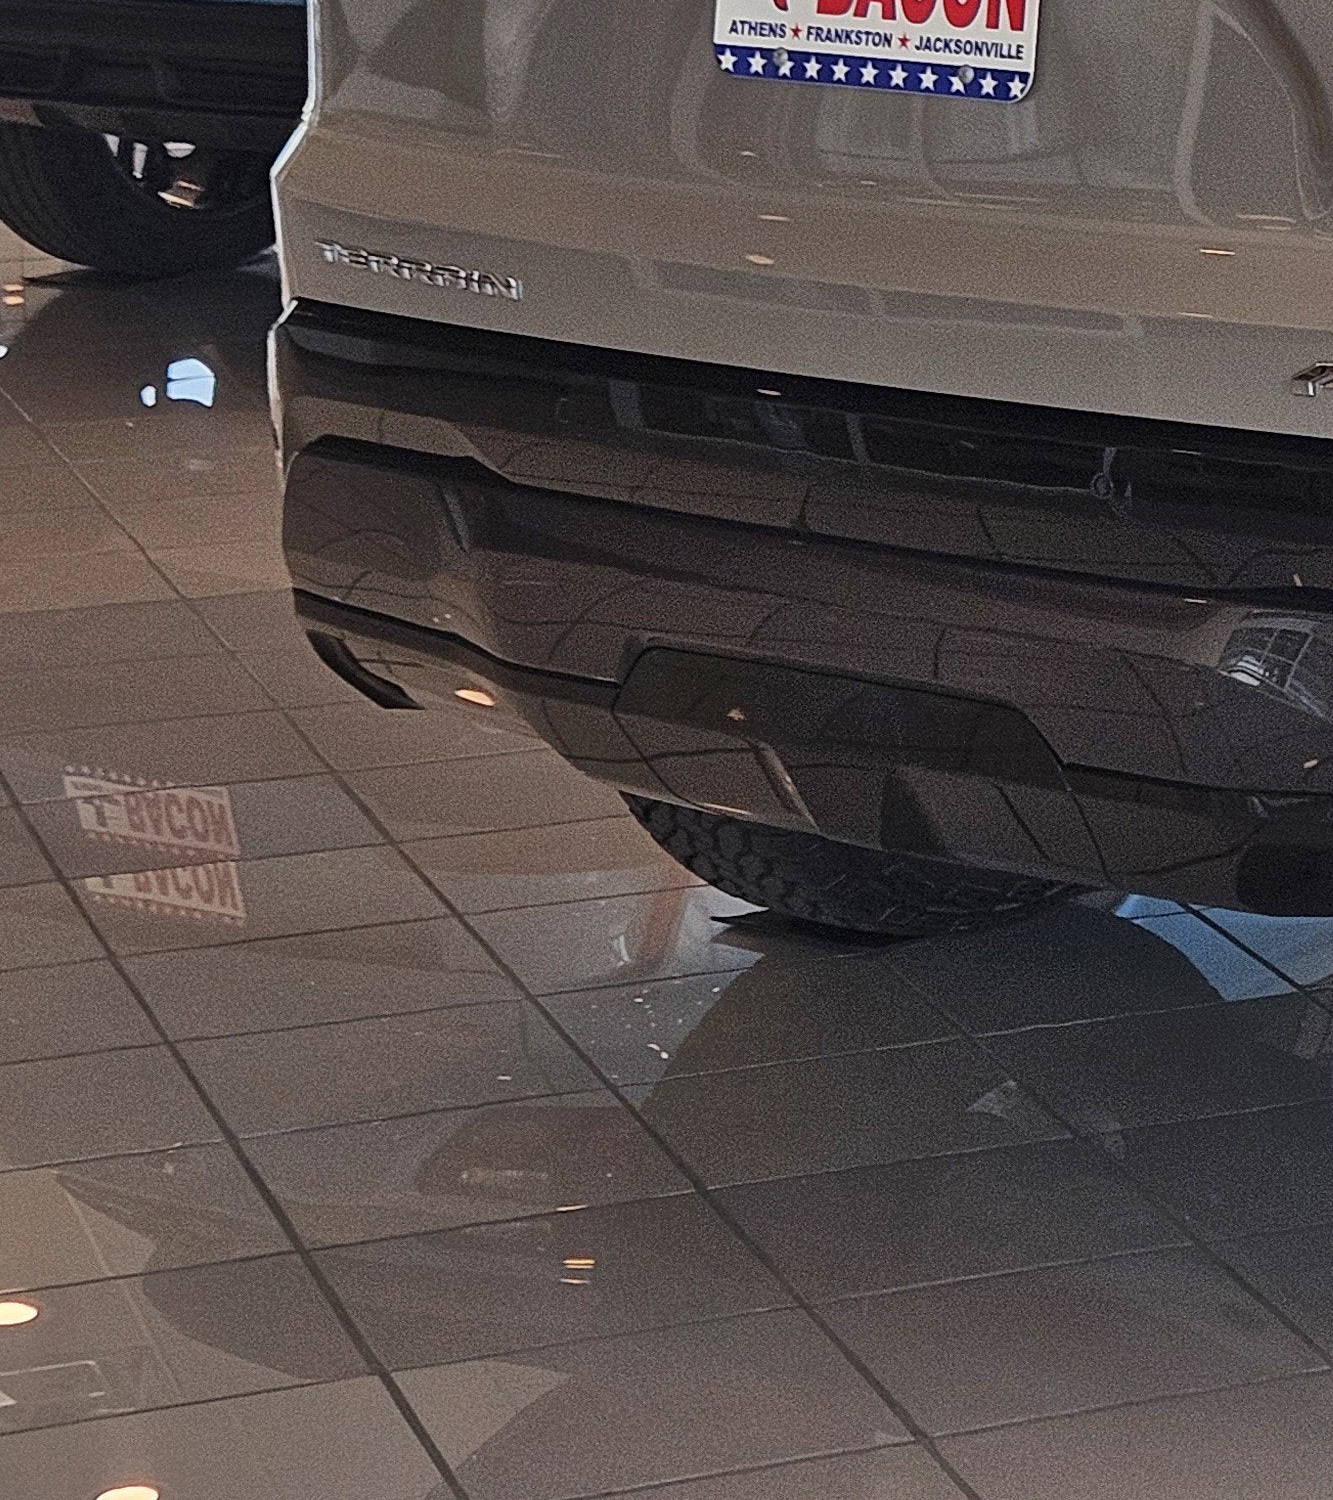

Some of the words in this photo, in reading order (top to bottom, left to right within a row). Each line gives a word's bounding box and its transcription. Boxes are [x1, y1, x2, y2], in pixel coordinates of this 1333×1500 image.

[728, 19, 787, 39] ATHENS
[806, 25, 893, 49] FRANKSTON
[914, 34, 1025, 61] JACKSONVILLE
[315, 239, 523, 301] TERRAIN
